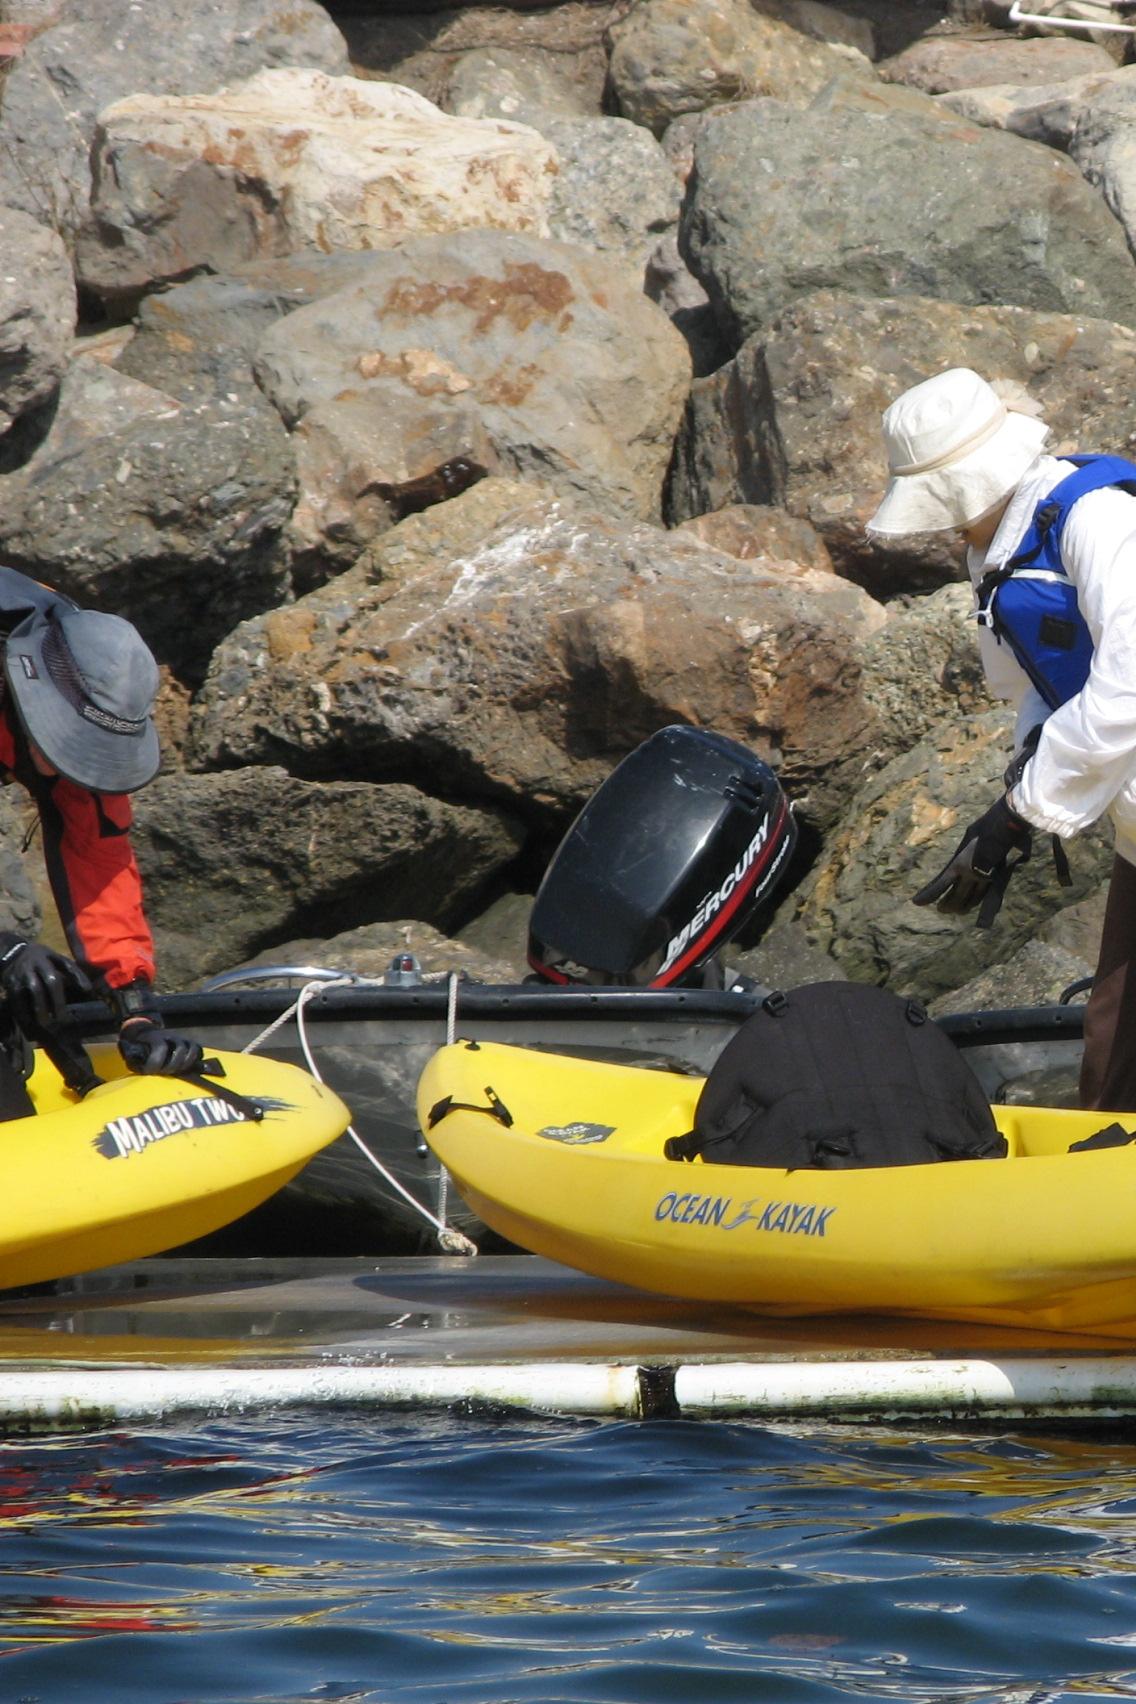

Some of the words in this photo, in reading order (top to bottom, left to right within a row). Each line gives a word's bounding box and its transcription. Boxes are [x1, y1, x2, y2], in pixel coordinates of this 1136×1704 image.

[656, 812, 769, 976] MERCURY
[107, 1102, 194, 1158] MALIBU
[655, 1192, 731, 1226] OCEAN
[756, 1201, 836, 1237] KAYAK
